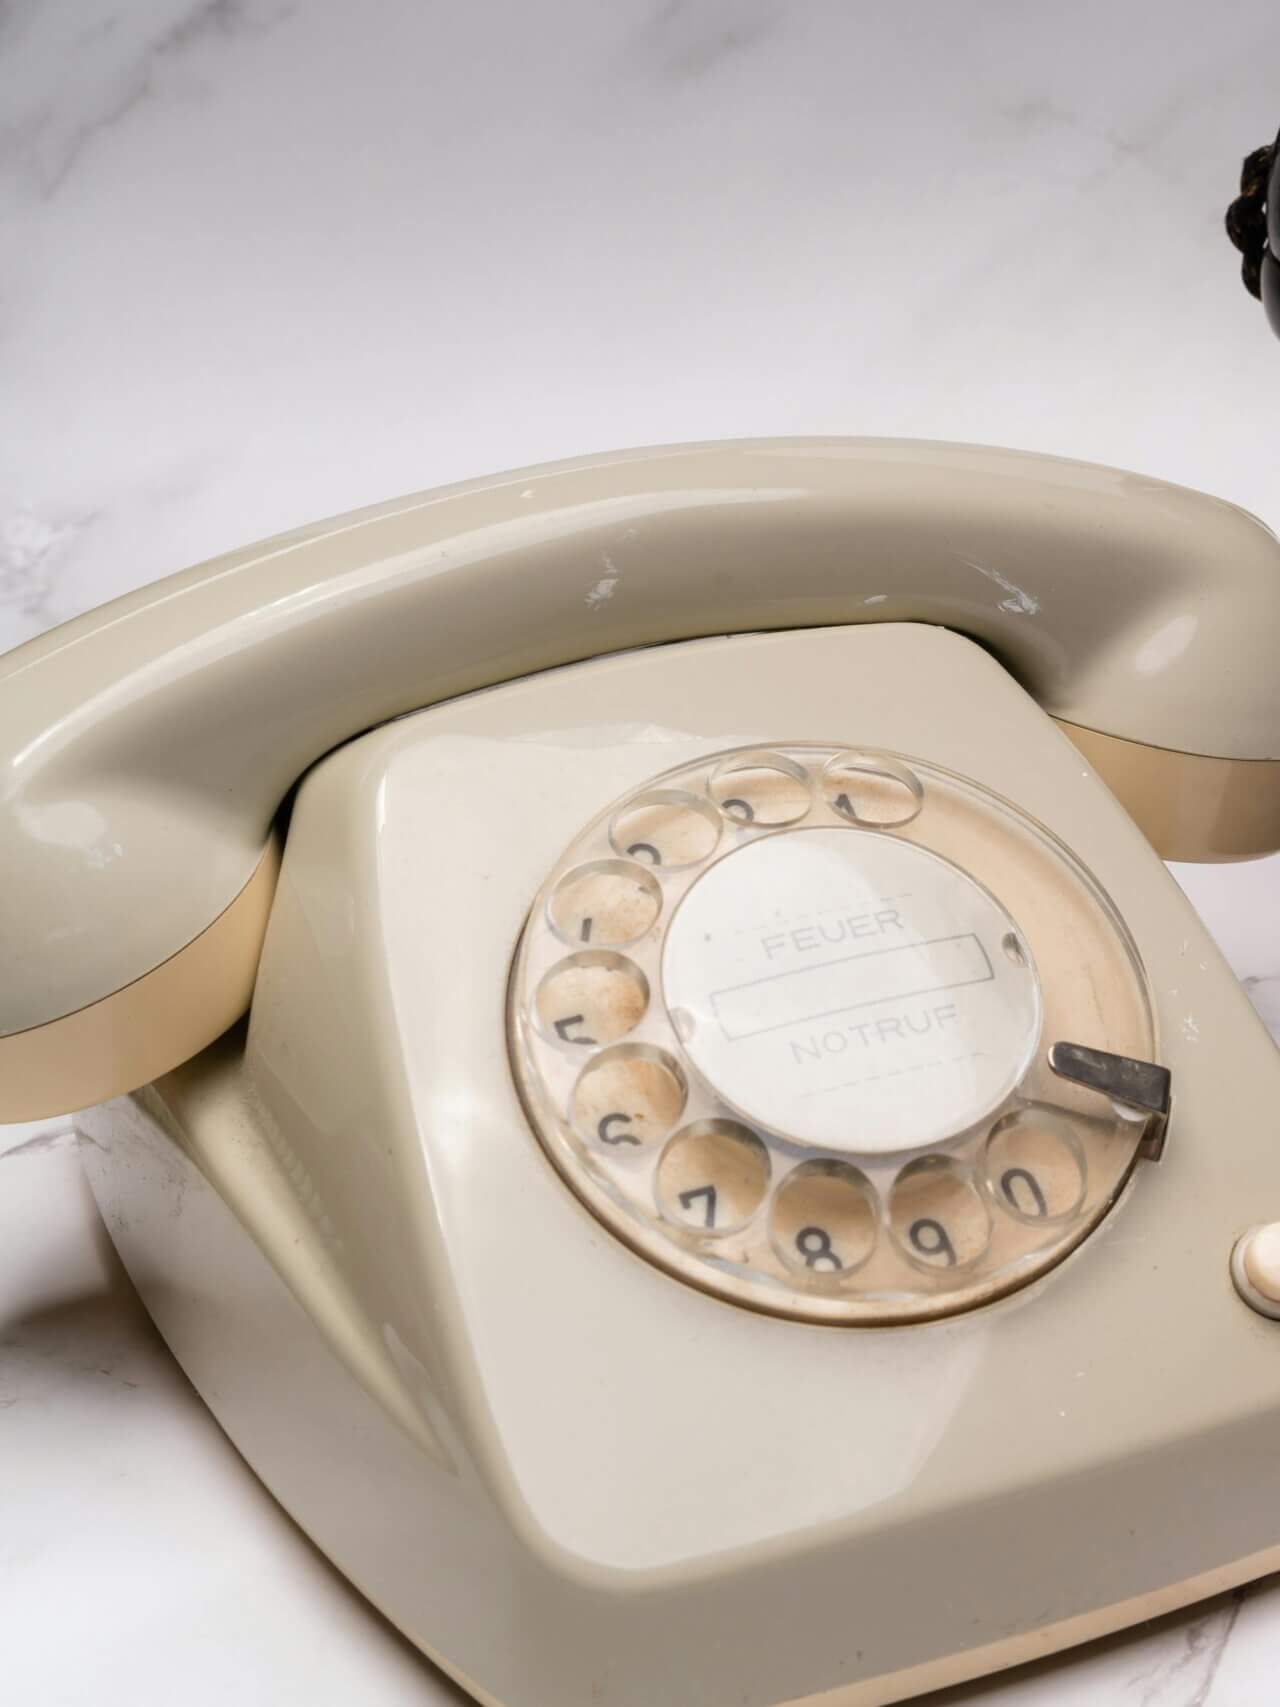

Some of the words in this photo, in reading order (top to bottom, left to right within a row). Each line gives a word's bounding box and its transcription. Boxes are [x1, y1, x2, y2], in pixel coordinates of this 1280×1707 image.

[760, 909, 905, 961] FEUER
[790, 1003, 958, 1066] NOTRUF
[679, 1185, 716, 1228] 7
[795, 1226, 843, 1271] 8
[909, 1218, 957, 1267] 9
